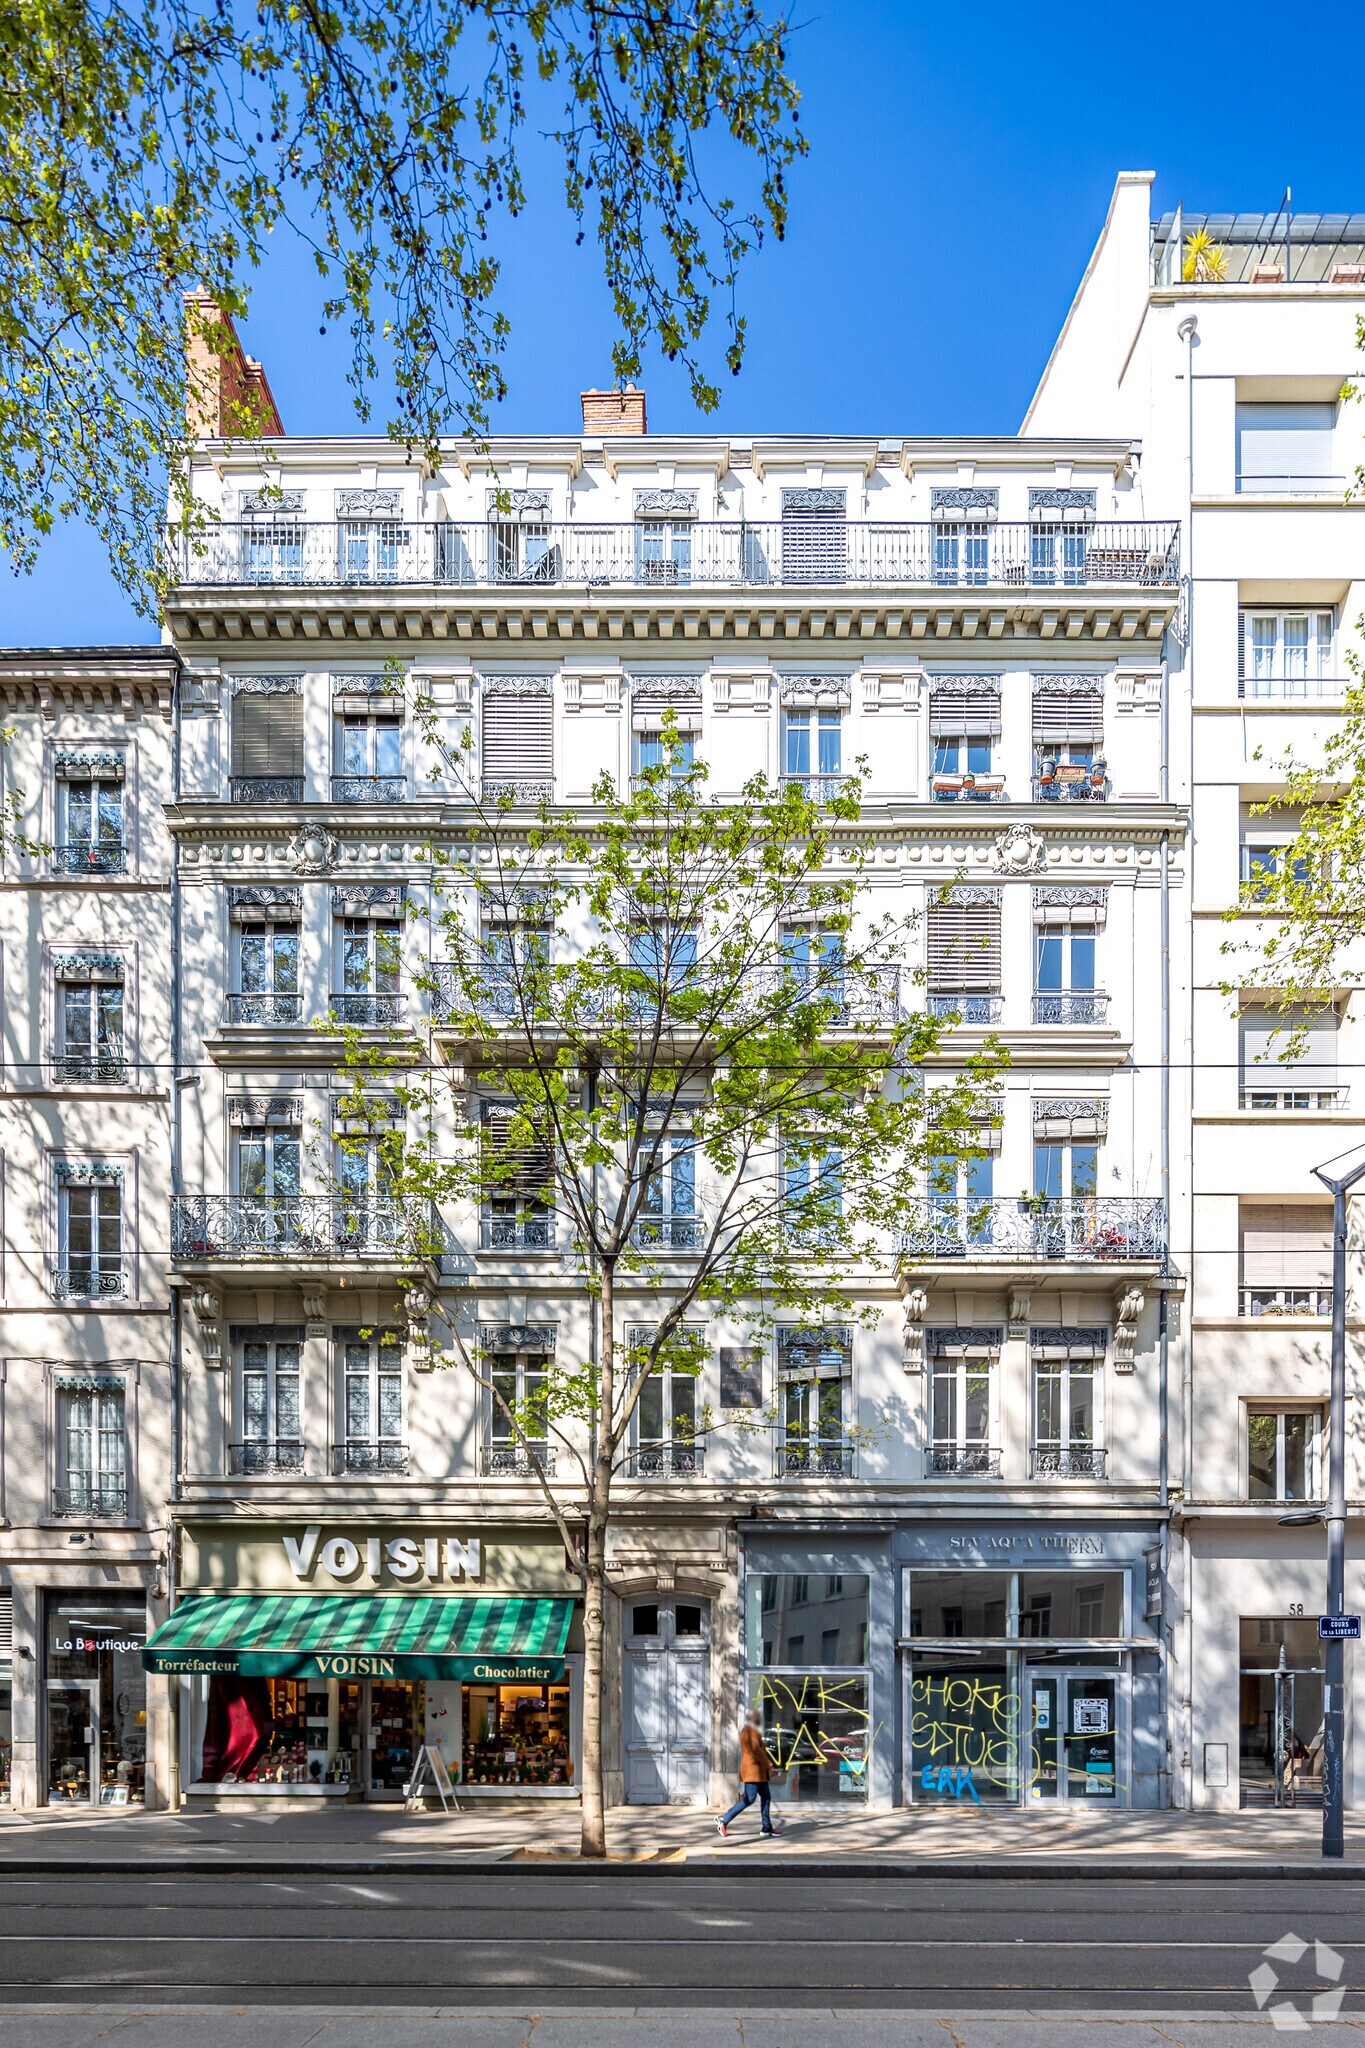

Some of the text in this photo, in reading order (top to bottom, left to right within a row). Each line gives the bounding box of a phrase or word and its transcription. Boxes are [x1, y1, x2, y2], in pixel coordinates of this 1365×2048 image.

[950, 1536, 982, 1548] SLV
[987, 1536, 1035, 1548] AQUA
[283, 1525, 482, 1578] VOISIN
[1289, 1603, 1303, 1616] 58
[1335, 1627, 1358, 1635] LIBERTÉ
[55, 1638, 73, 1650] La
[155, 1656, 551, 1679] Torréfacteur VOISIN Chocolatier
[920, 1764, 982, 1805] ERK
